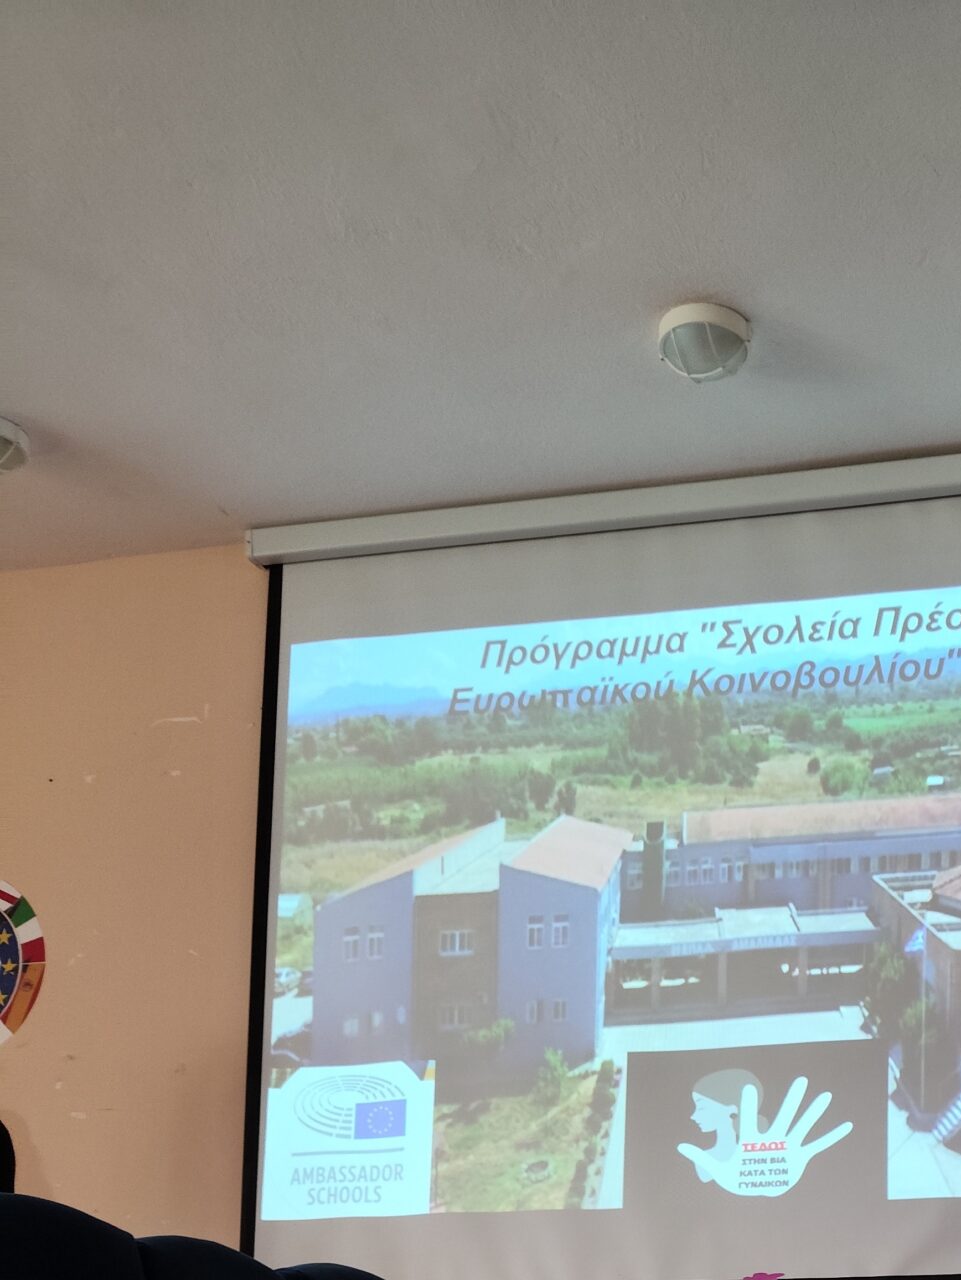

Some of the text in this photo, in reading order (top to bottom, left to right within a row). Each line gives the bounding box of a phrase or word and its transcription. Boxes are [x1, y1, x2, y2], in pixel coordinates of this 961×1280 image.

[480, 631, 688, 674] Πρόγραμμα
[700, 611, 862, 655] "Σχολεία
[448, 671, 676, 719] Ευρωπαϊκού
[290, 1164, 405, 1185] AMBASSADOR
[739, 1169, 765, 1177] ΚΑΤΑ
[738, 1180, 789, 1189] ΓΥΝΑΙΚΩΝ
[307, 1185, 382, 1206] SCHOOLS
